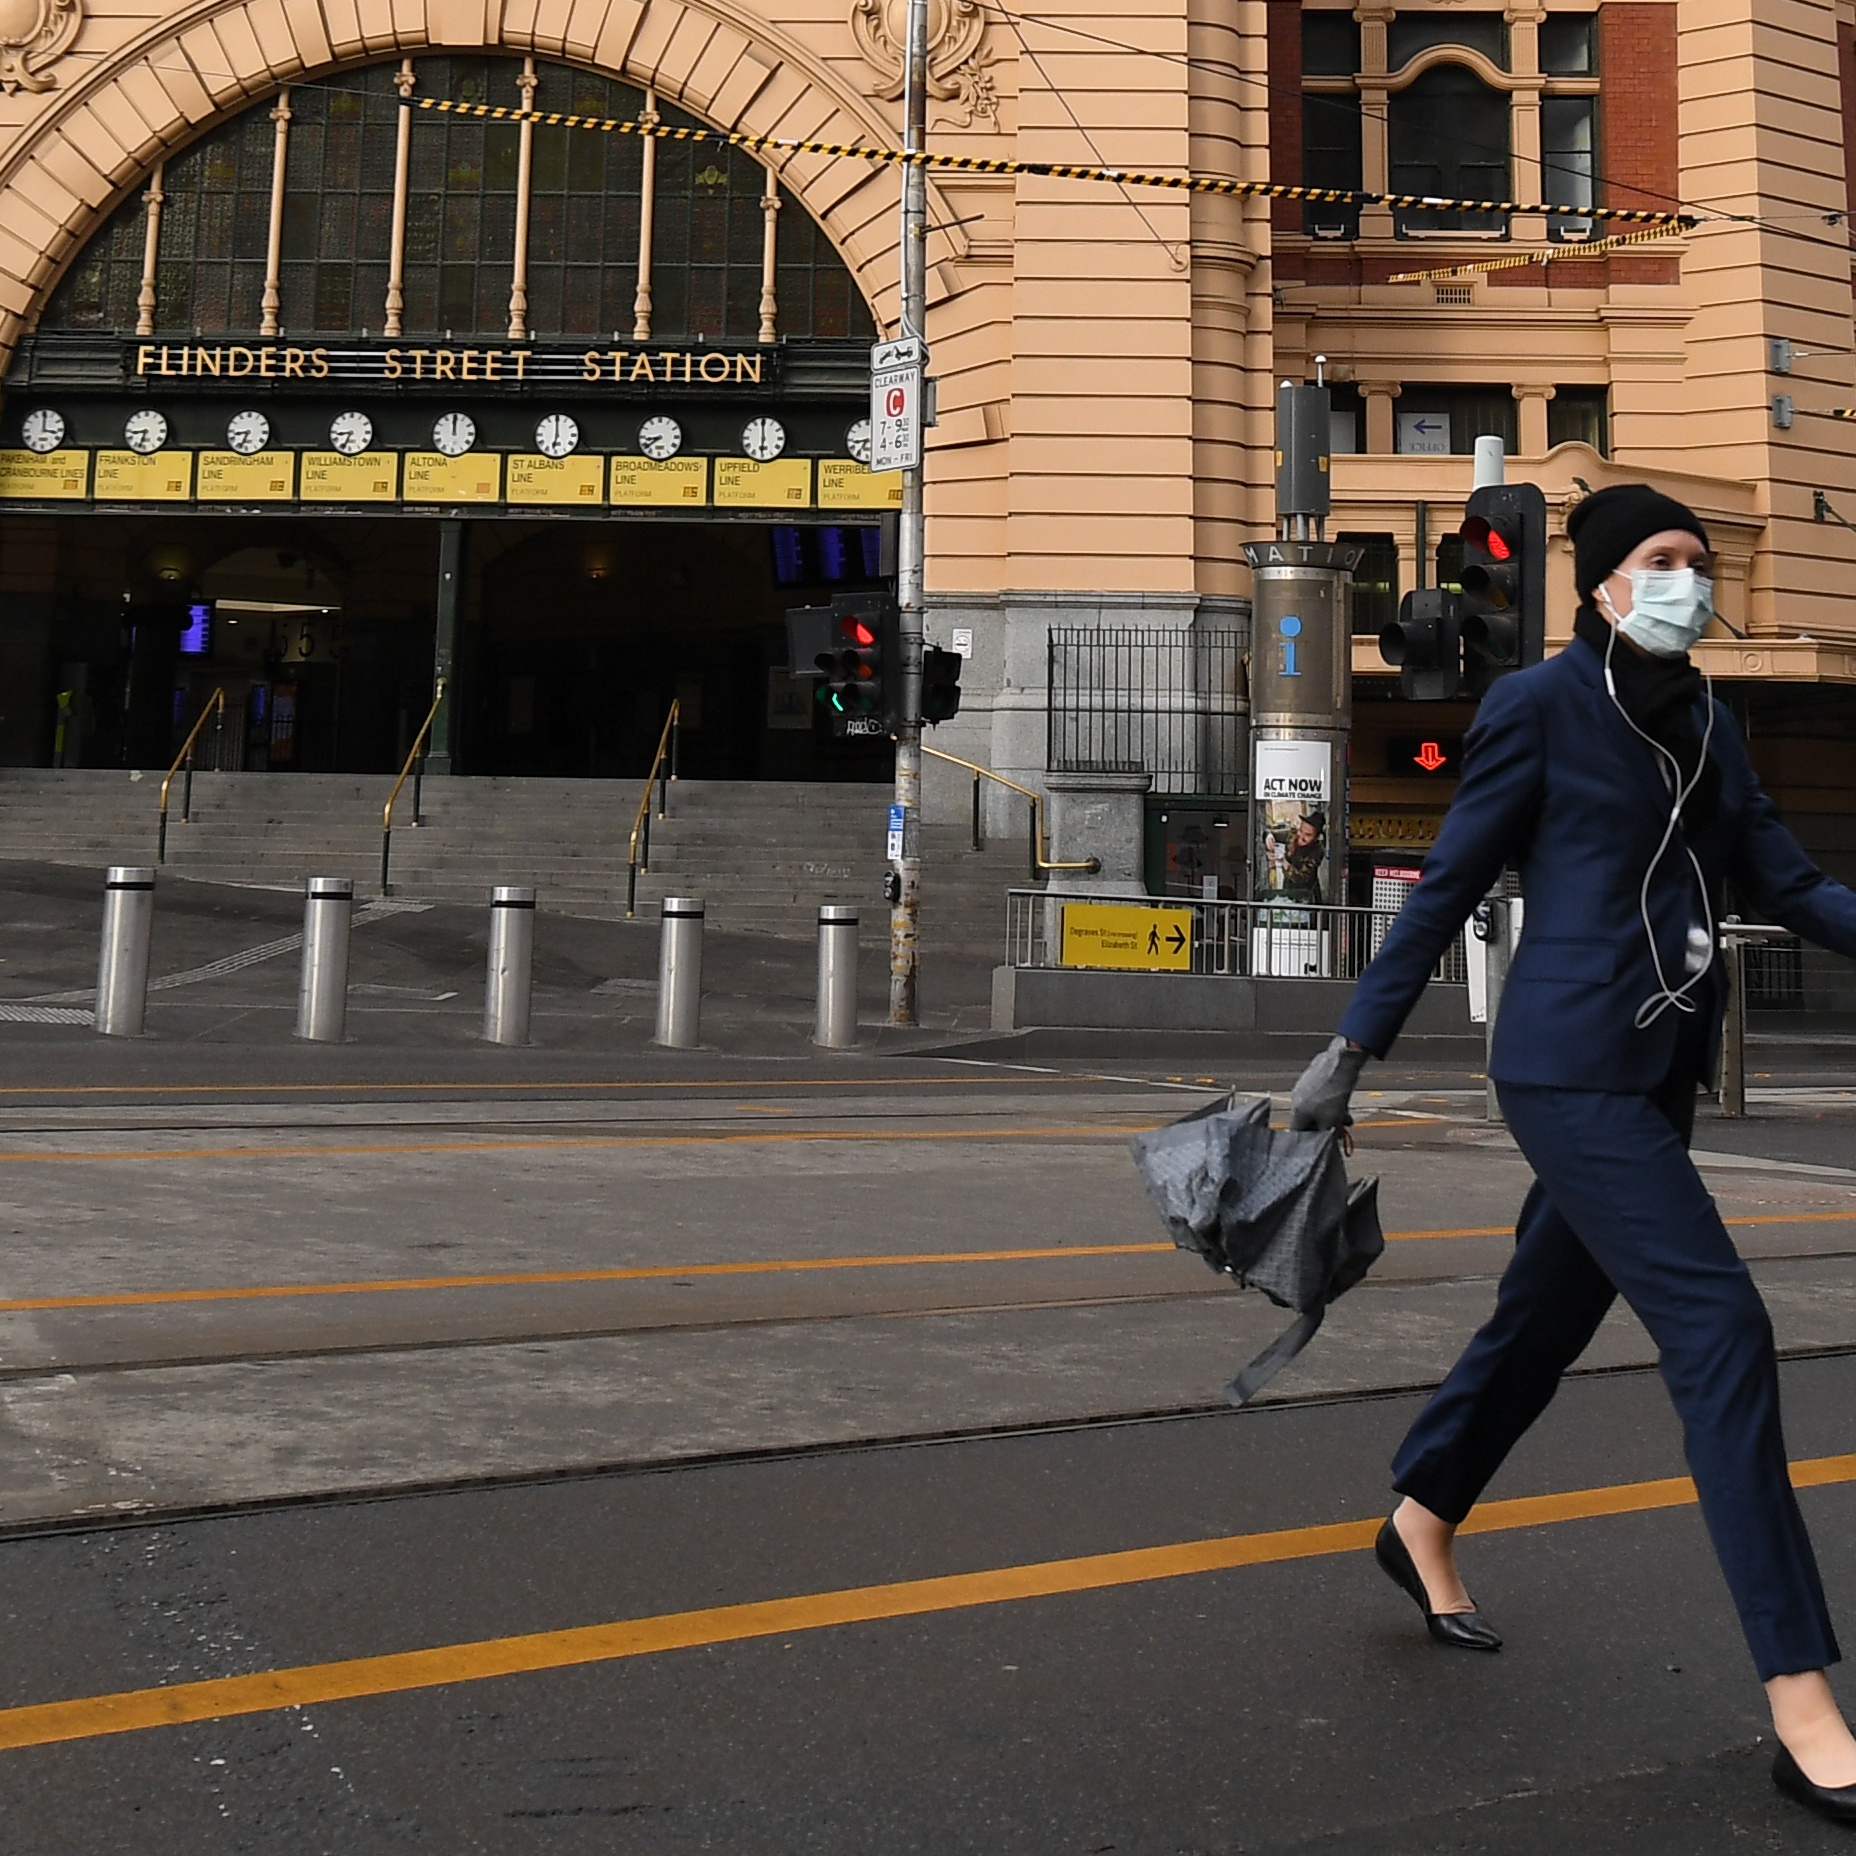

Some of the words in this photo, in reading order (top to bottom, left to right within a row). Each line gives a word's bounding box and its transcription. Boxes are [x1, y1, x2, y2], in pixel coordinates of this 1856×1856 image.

[136, 345, 329, 379] FLINDERS
[384, 348, 532, 381] STREET
[582, 351, 762, 384] STATION
[874, 371, 915, 388] CLEARWAY
[0, 454, 46, 464] PAKENHAM
[99, 455, 156, 466] FRANKSTON
[203, 456, 274, 466] SANDRINGHAM
[307, 457, 381, 467] WILLIAMSTOWN
[410, 457, 448, 467] ALTONA
[513, 459, 526, 469] ST
[527, 460, 565, 470] ALBANS
[615, 461, 699, 472] BROADMEADOWS
[720, 463, 760, 473] UPFIELD
[0, 467, 59, 478] CRANBOURNE
[60, 468, 85, 479] LINES
[98, 468, 118, 479] LINE
[202, 470, 223, 480] LINE
[306, 470, 327, 480] LINE
[409, 471, 430, 481] LINE
[511, 473, 533, 483] LINE
[615, 474, 637, 485] LINE
[719, 476, 741, 486] LINE
[823, 478, 844, 488] LINE
[1263, 778, 1285, 791] ACT
[1288, 778, 1322, 792] NOW
[1070, 927, 1098, 937] Degraves
[1099, 926, 1107, 937] St
[1101, 940, 1129, 949] Elizabeth
[1131, 941, 1138, 950] St
